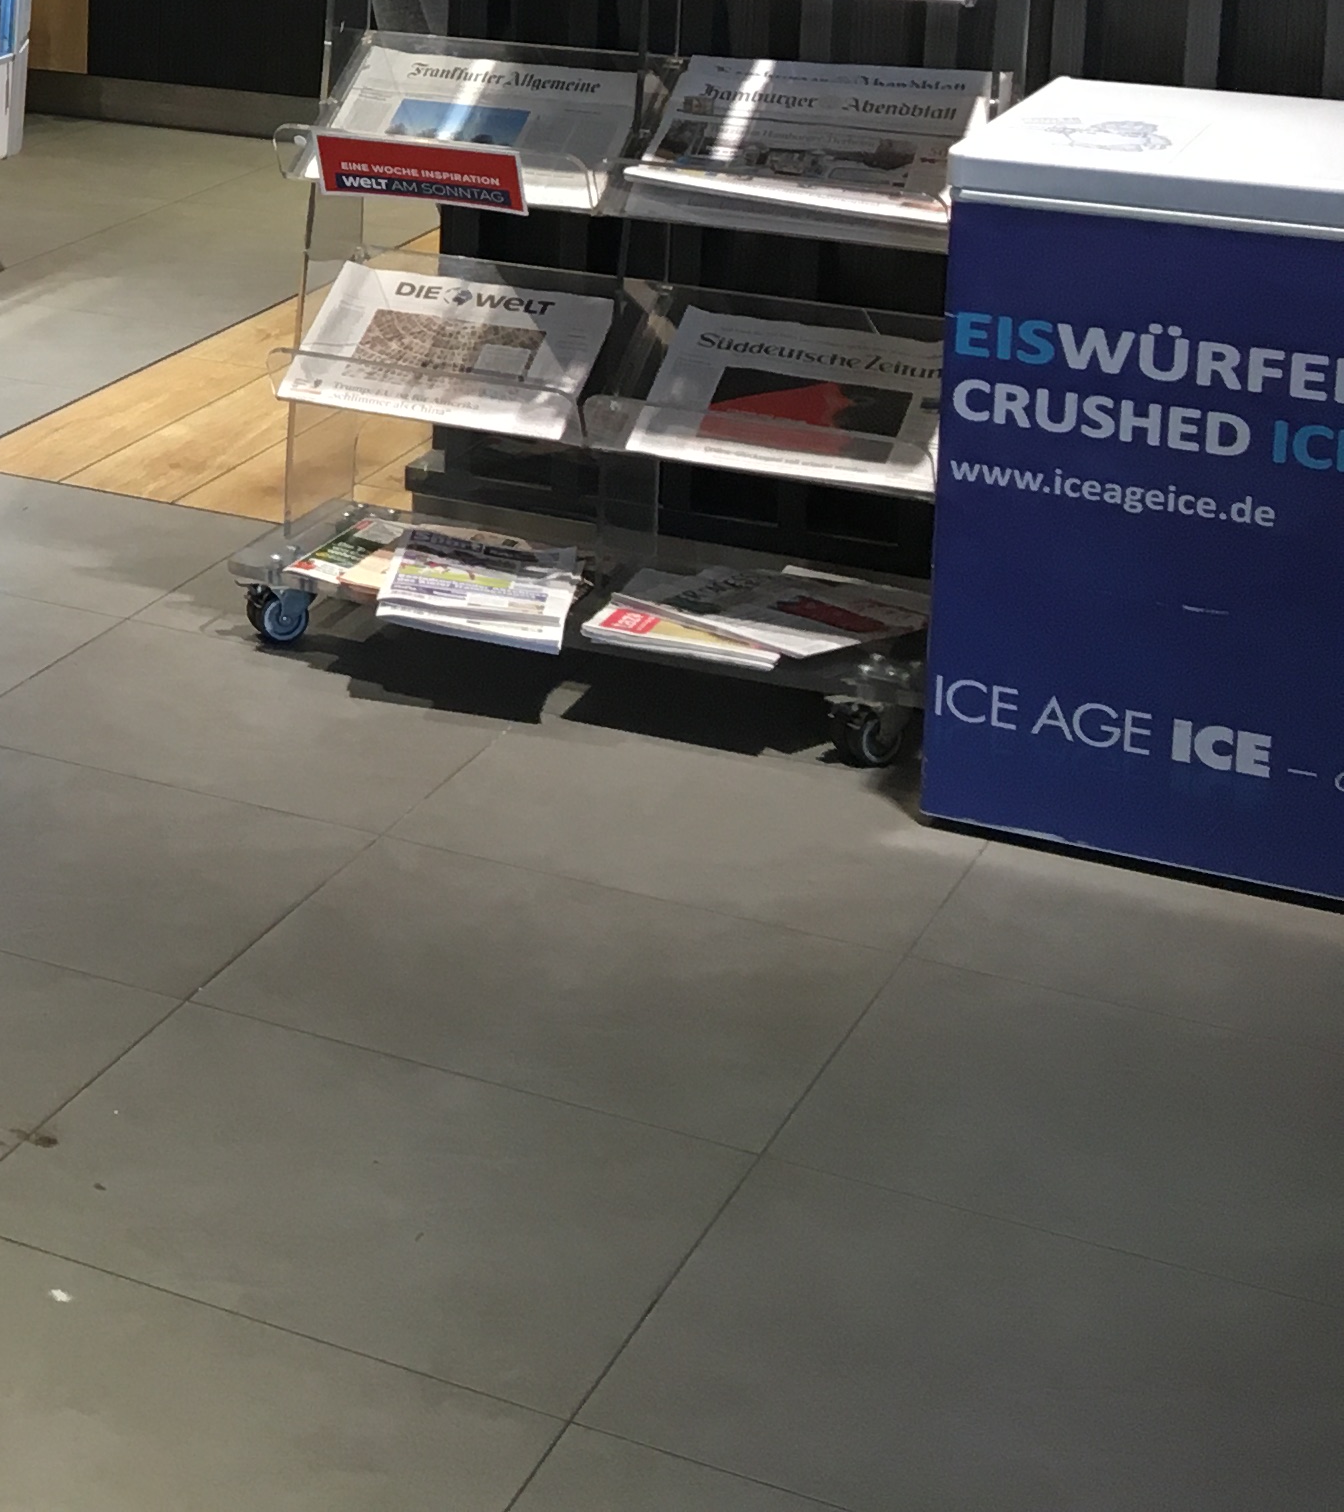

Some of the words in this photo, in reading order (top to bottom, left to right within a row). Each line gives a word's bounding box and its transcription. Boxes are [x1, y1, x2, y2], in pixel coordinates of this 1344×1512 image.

[407, 62, 505, 87] Frankfurter
[503, 70, 602, 94] Allgemeine
[699, 83, 819, 110] Hamburger
[841, 96, 960, 122] Abendblatt
[340, 161, 369, 172] EINE
[371, 163, 420, 177] WOCHE
[421, 168, 501, 186] INSPIRATION
[391, 180, 418, 194] AM
[424, 182, 505, 204] SONNTAG
[395, 281, 443, 301] DIE
[696, 331, 861, 370] Süddeutsche
[862, 354, 943, 380] Zeitun
[952, 378, 1251, 457] CRUSHED
[950, 458, 1276, 528] www.iceageice.de
[934, 675, 1020, 731] ICE
[1031, 696, 1153, 756] AGE
[1171, 718, 1272, 778] ICE
